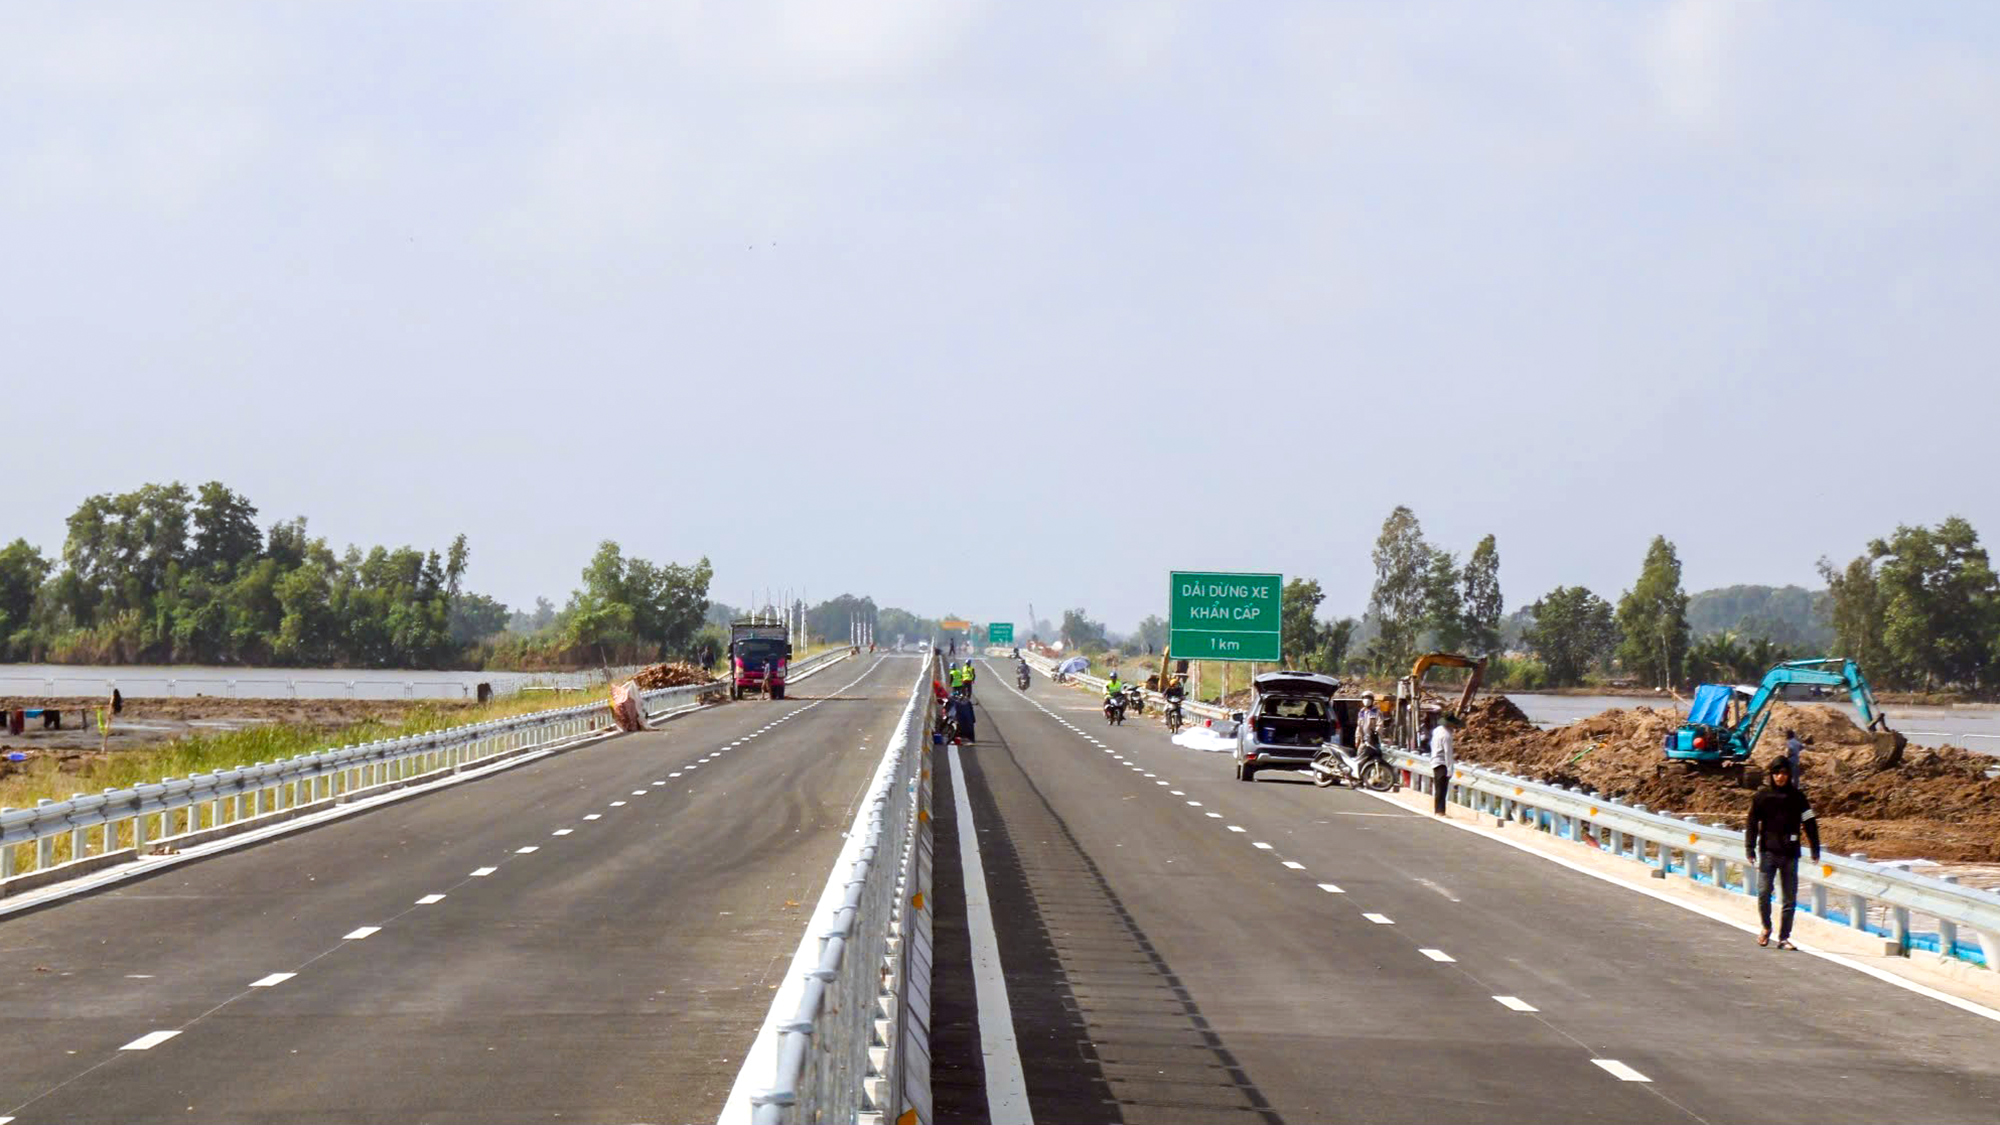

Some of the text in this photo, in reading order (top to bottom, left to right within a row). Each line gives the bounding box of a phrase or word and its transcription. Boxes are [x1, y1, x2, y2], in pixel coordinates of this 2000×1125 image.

[1182, 580, 1269, 599] DẢI DỪNG XE
[1190, 600, 1260, 620] KHẨN CẤP
[1210, 638, 1240, 650] 1 km
